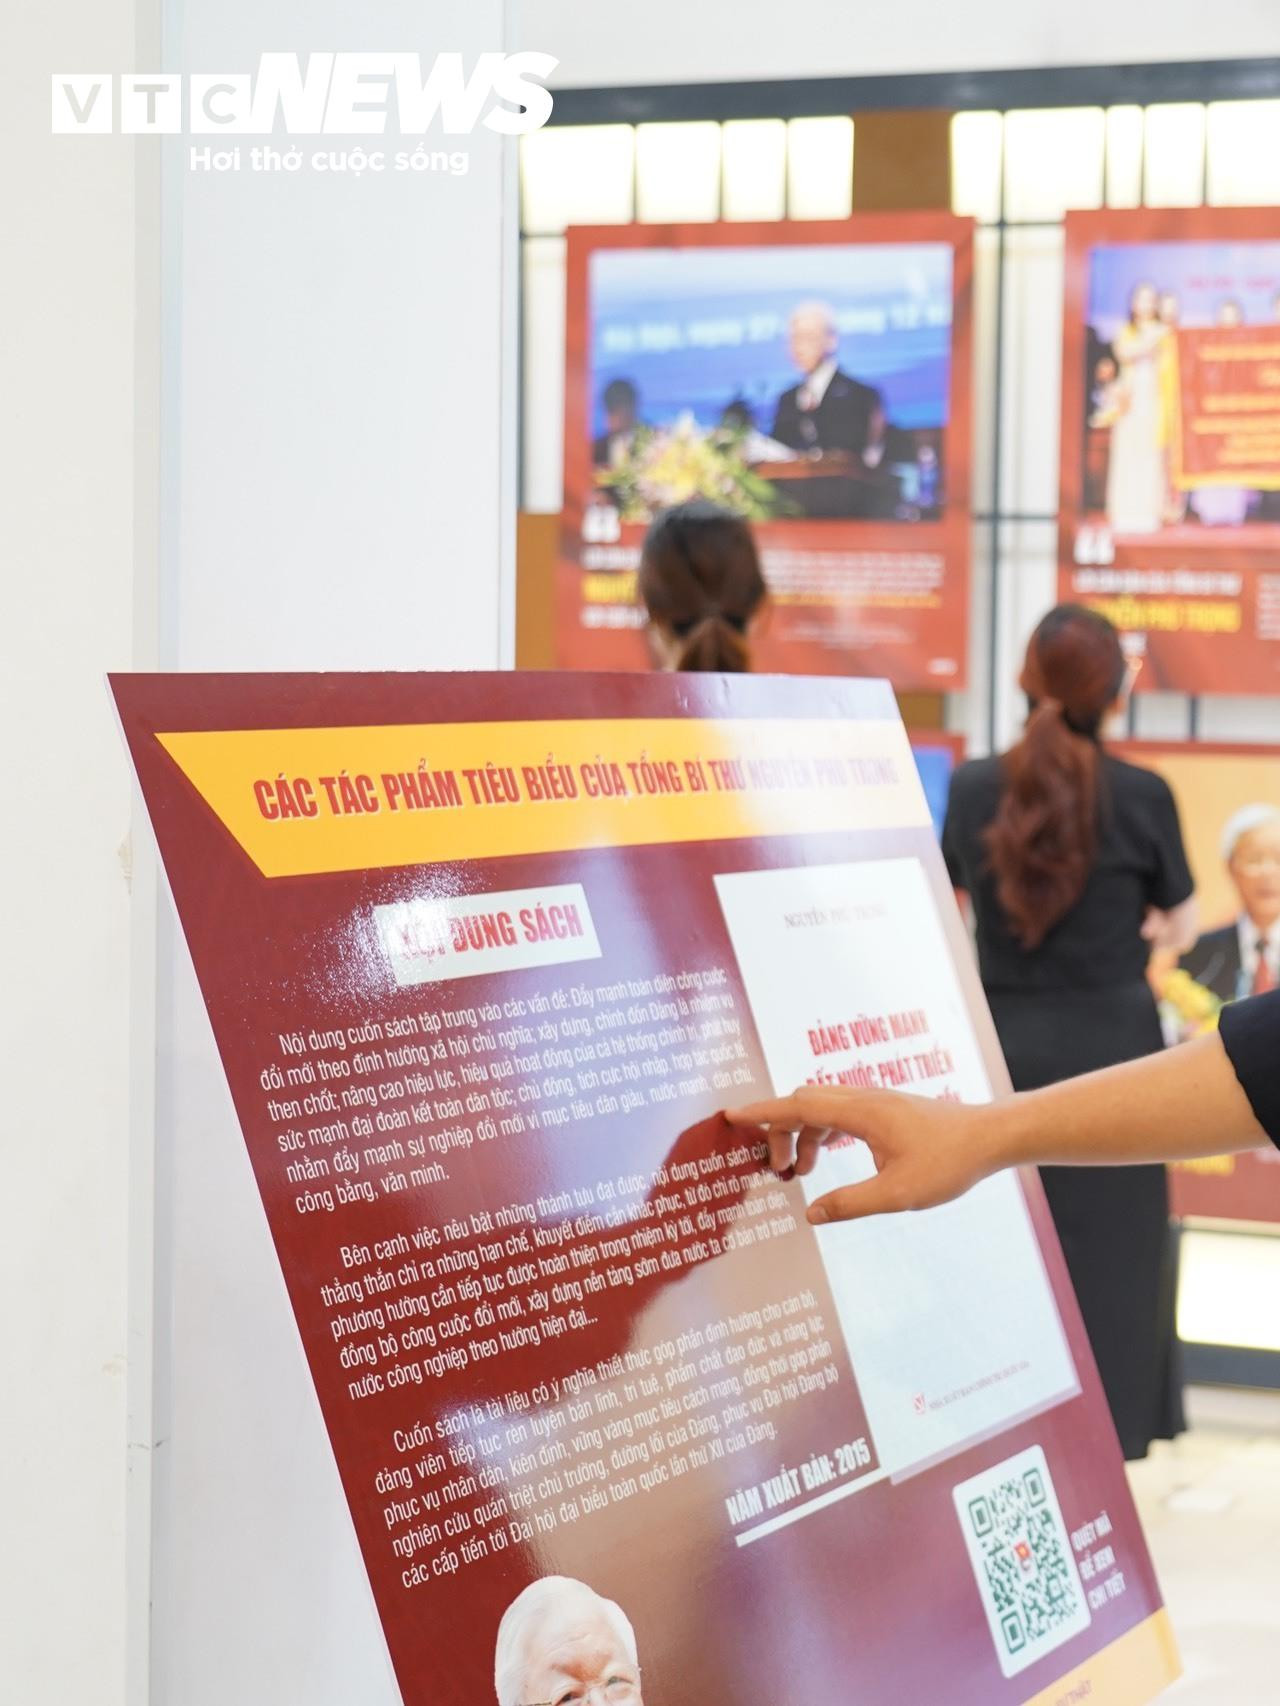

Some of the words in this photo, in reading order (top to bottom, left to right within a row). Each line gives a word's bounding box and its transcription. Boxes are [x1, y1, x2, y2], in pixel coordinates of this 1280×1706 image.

[253, 772, 319, 822] CÁC
[320, 768, 380, 817] TÁC
[381, 757, 463, 811] PHẨM
[462, 761, 521, 806] TIÊU
[522, 752, 579, 802] BIỂU
[581, 754, 629, 799] CỦA
[628, 750, 684, 797] TỔNG
[684, 757, 709, 793] BÍ
[708, 757, 747, 792] THƯ
[448, 910, 518, 954] DUNG
[519, 901, 585, 944] SÁCH
[278, 1031, 306, 1056] Nội
[308, 1029, 346, 1050] dung
[347, 1017, 383, 1043] cuốn
[384, 1014, 418, 1037] sách
[418, 1011, 441, 1034] tập
[441, 1008, 478, 1028] trung
[808, 1018, 852, 1057] ĐẢNG
[259, 1063, 285, 1090] đổi
[286, 1061, 316, 1085] mới
[316, 1059, 350, 1080] theo
[352, 1050, 384, 1075] định
[429, 1039, 448, 1059] xã
[267, 1099, 302, 1121] then
[303, 1087, 340, 1114] chốt;
[341, 1085, 377, 1107] nâng
[378, 1081, 404, 1100] cao
[403, 1072, 434, 1095] hiệu
[433, 1069, 460, 1091] lực,
[277, 1129, 305, 1152] sức
[307, 1119, 349, 1146] mạnh
[351, 1113, 373, 1138] đại
[375, 1108, 410, 1131] đoàn
[410, 1099, 434, 1123] kết
[433, 1097, 464, 1119] toàn
[286, 1155, 329, 1183] nhằm
[332, 1145, 359, 1173] đẩy
[363, 1139, 405, 1165] mạnh
[407, 1136, 425, 1157] sự
[428, 1125, 473, 1154] nghiệp
[476, 1115, 498, 1141] đổi
[295, 1190, 334, 1213] công
[335, 1178, 378, 1203] bằng,
[380, 1171, 408, 1193] văn
[409, 1161, 449, 1186] minh.
[320, 1276, 363, 1306] thẳng
[363, 1267, 396, 1294] thắn
[397, 1259, 419, 1285] chỉ
[420, 1261, 436, 1278] ra
[436, 1249, 479, 1274] những
[477, 1242, 504, 1263] hạn
[505, 1228, 533, 1255] chế,
[339, 1244, 371, 1267] Bên
[374, 1232, 410, 1260] cạnh
[410, 1225, 440, 1249] việc
[443, 1218, 469, 1241] nêu
[469, 1211, 494, 1233] bật
[494, 1203, 536, 1227] những
[330, 1308, 385, 1342] phương
[431, 1282, 456, 1308] cần
[456, 1273, 482, 1301] tiếp
[482, 1273, 504, 1292] tục
[506, 1262, 538, 1286] được
[537, 1252, 570, 1276] hoàn
[339, 1342, 377, 1368] đồng
[377, 1332, 398, 1356] bộ
[401, 1325, 436, 1349] công
[438, 1312, 471, 1338] cuộc
[474, 1300, 495, 1327] đổi
[496, 1294, 526, 1320] mới,
[526, 1288, 548, 1311] xây
[348, 1372, 384, 1400] nước
[386, 1362, 422, 1387] công
[423, 1346, 468, 1377] nghiệp
[468, 1338, 498, 1360] theo
[539, 1314, 567, 1338] hiện
[568, 1305, 598, 1329] đại...
[393, 1420, 433, 1452] Cuốn
[435, 1407, 469, 1438] sách
[468, 1403, 485, 1424] là
[485, 1395, 504, 1419] tài
[504, 1390, 530, 1413] liệu
[375, 1466, 413, 1493] đảng
[414, 1453, 446, 1478] viên
[448, 1438, 475, 1466] tiếp
[477, 1434, 501, 1455] tục
[725, 1488, 764, 1527] NĂM
[761, 1462, 803, 1509] XUẤT
[834, 1438, 872, 1475] 2015
[383, 1497, 420, 1530] phục
[421, 1490, 440, 1510] vụ
[441, 1475, 477, 1503] nhân
[478, 1465, 508, 1488] dân,
[392, 1523, 441, 1557] nghiên
[444, 1511, 471, 1536] cứu
[473, 1496, 507, 1527] quán
[508, 1483, 537, 1510] triệt
[401, 1562, 429, 1588] các
[432, 1546, 458, 1575] cấp
[460, 1535, 488, 1563] tiến
[488, 1526, 508, 1551] tới
[508, 1516, 534, 1543] Đại
